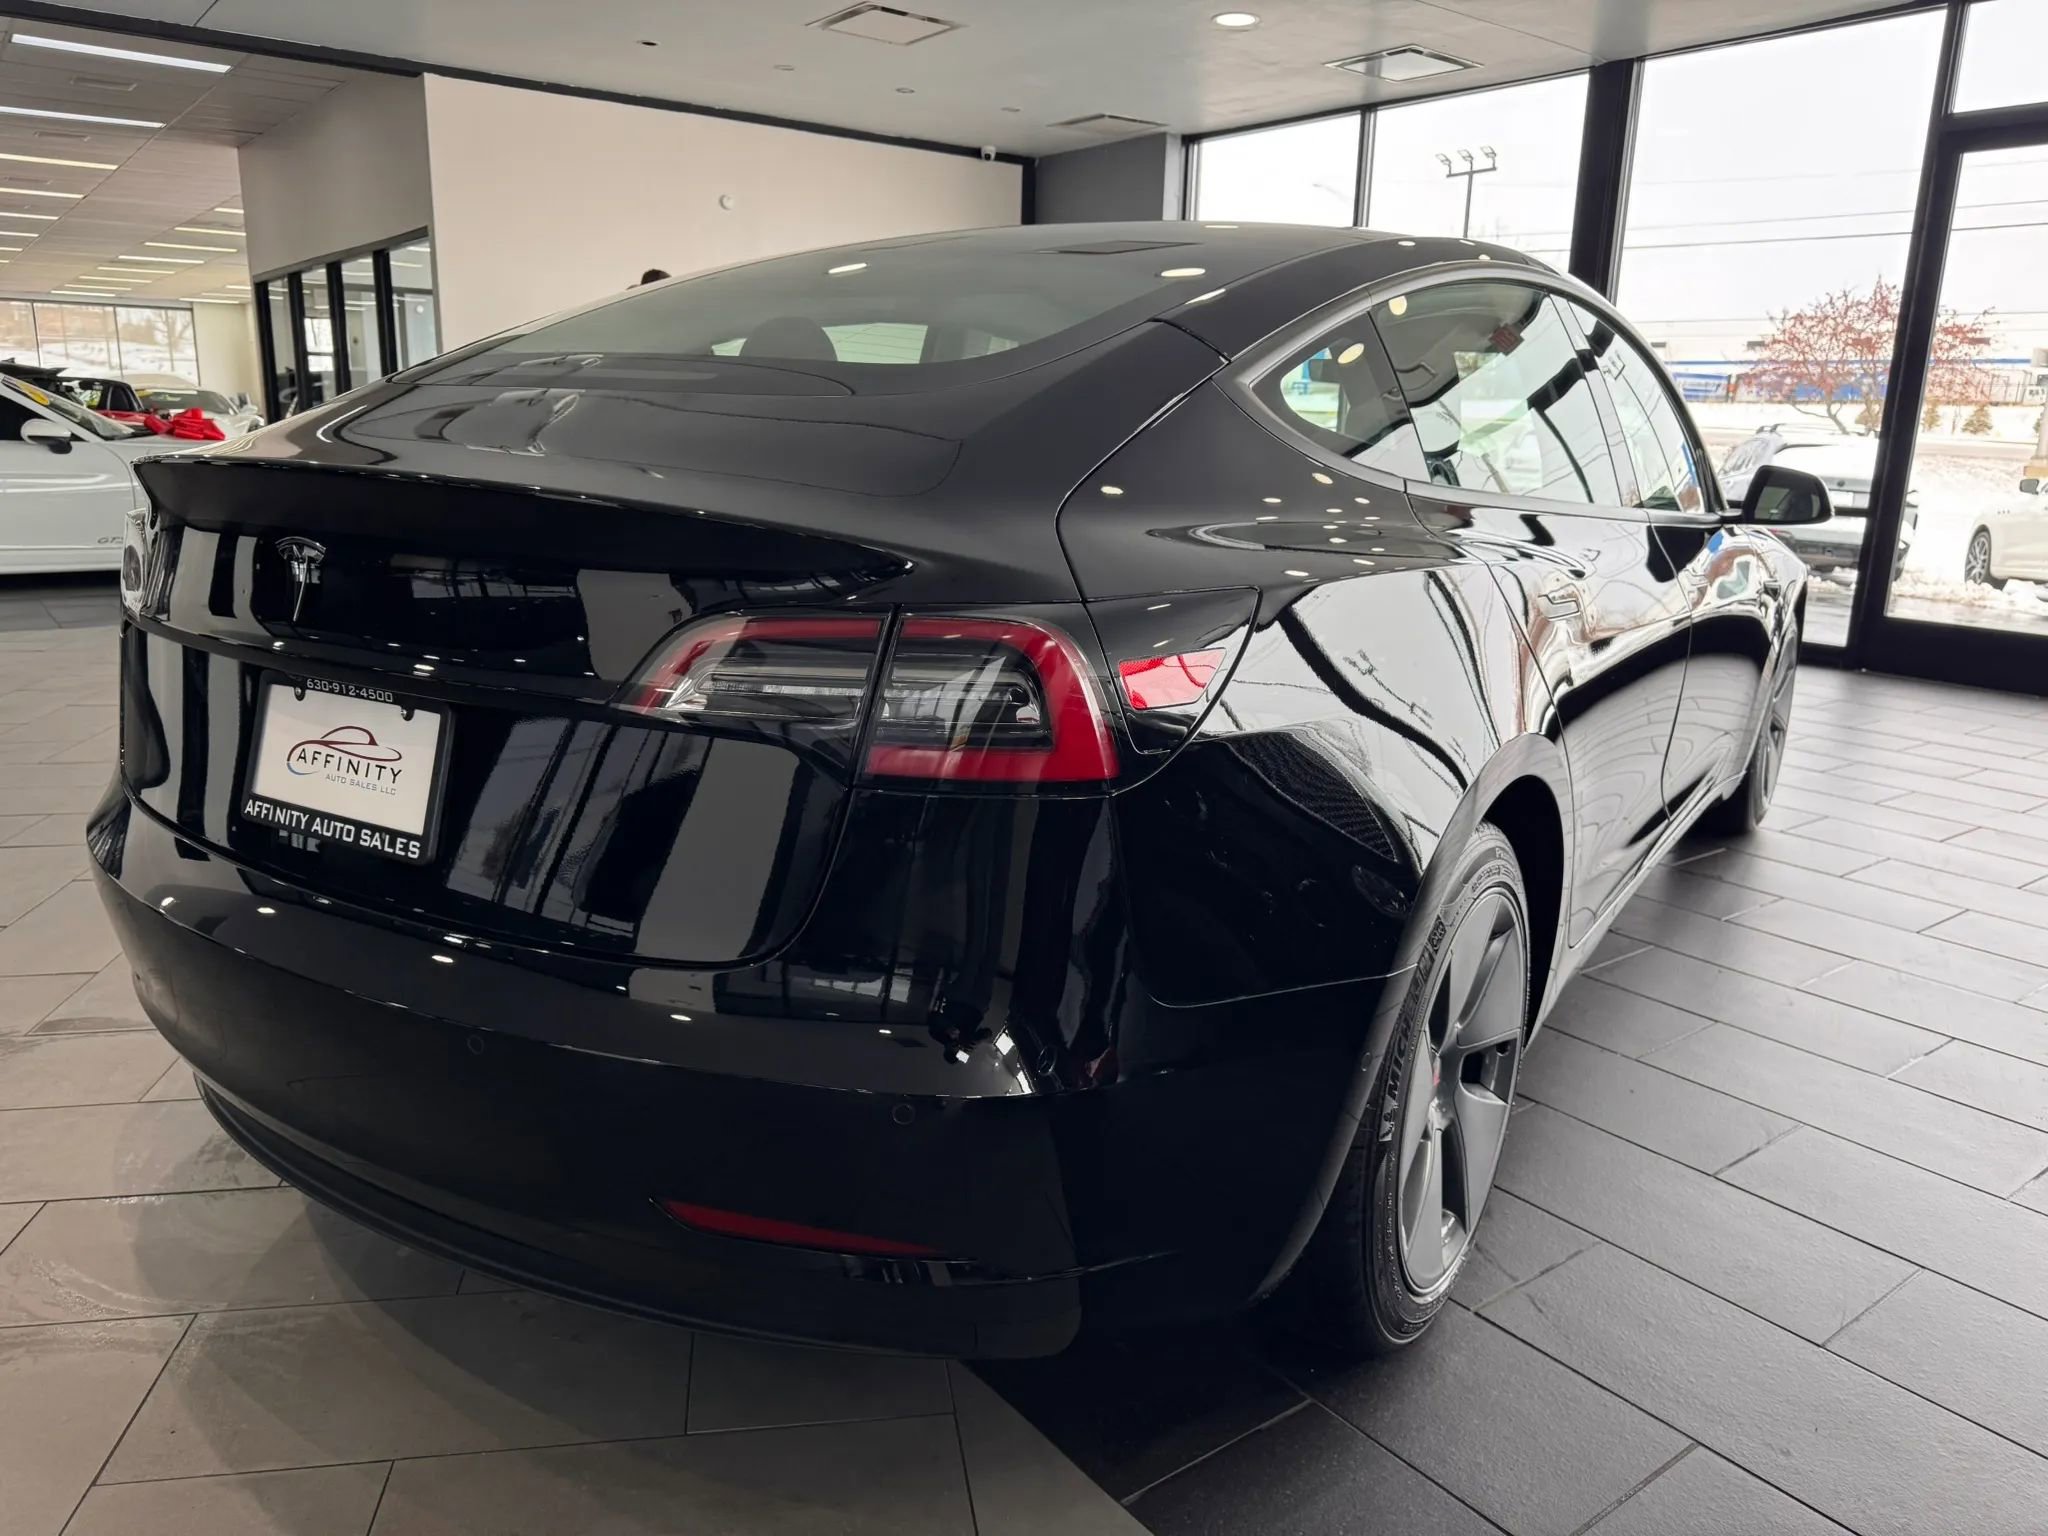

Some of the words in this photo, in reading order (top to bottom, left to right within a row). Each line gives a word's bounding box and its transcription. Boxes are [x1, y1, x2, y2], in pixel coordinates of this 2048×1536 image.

[306, 678, 393, 703] 630-912-4500
[296, 747, 403, 784] AFFINITY
[325, 773, 347, 785] AUTO
[349, 778, 378, 792] SALES
[380, 786, 397, 796] LLC
[244, 799, 310, 830] AFFINITY
[311, 816, 355, 843] AUTO
[359, 829, 422, 859] SALES
